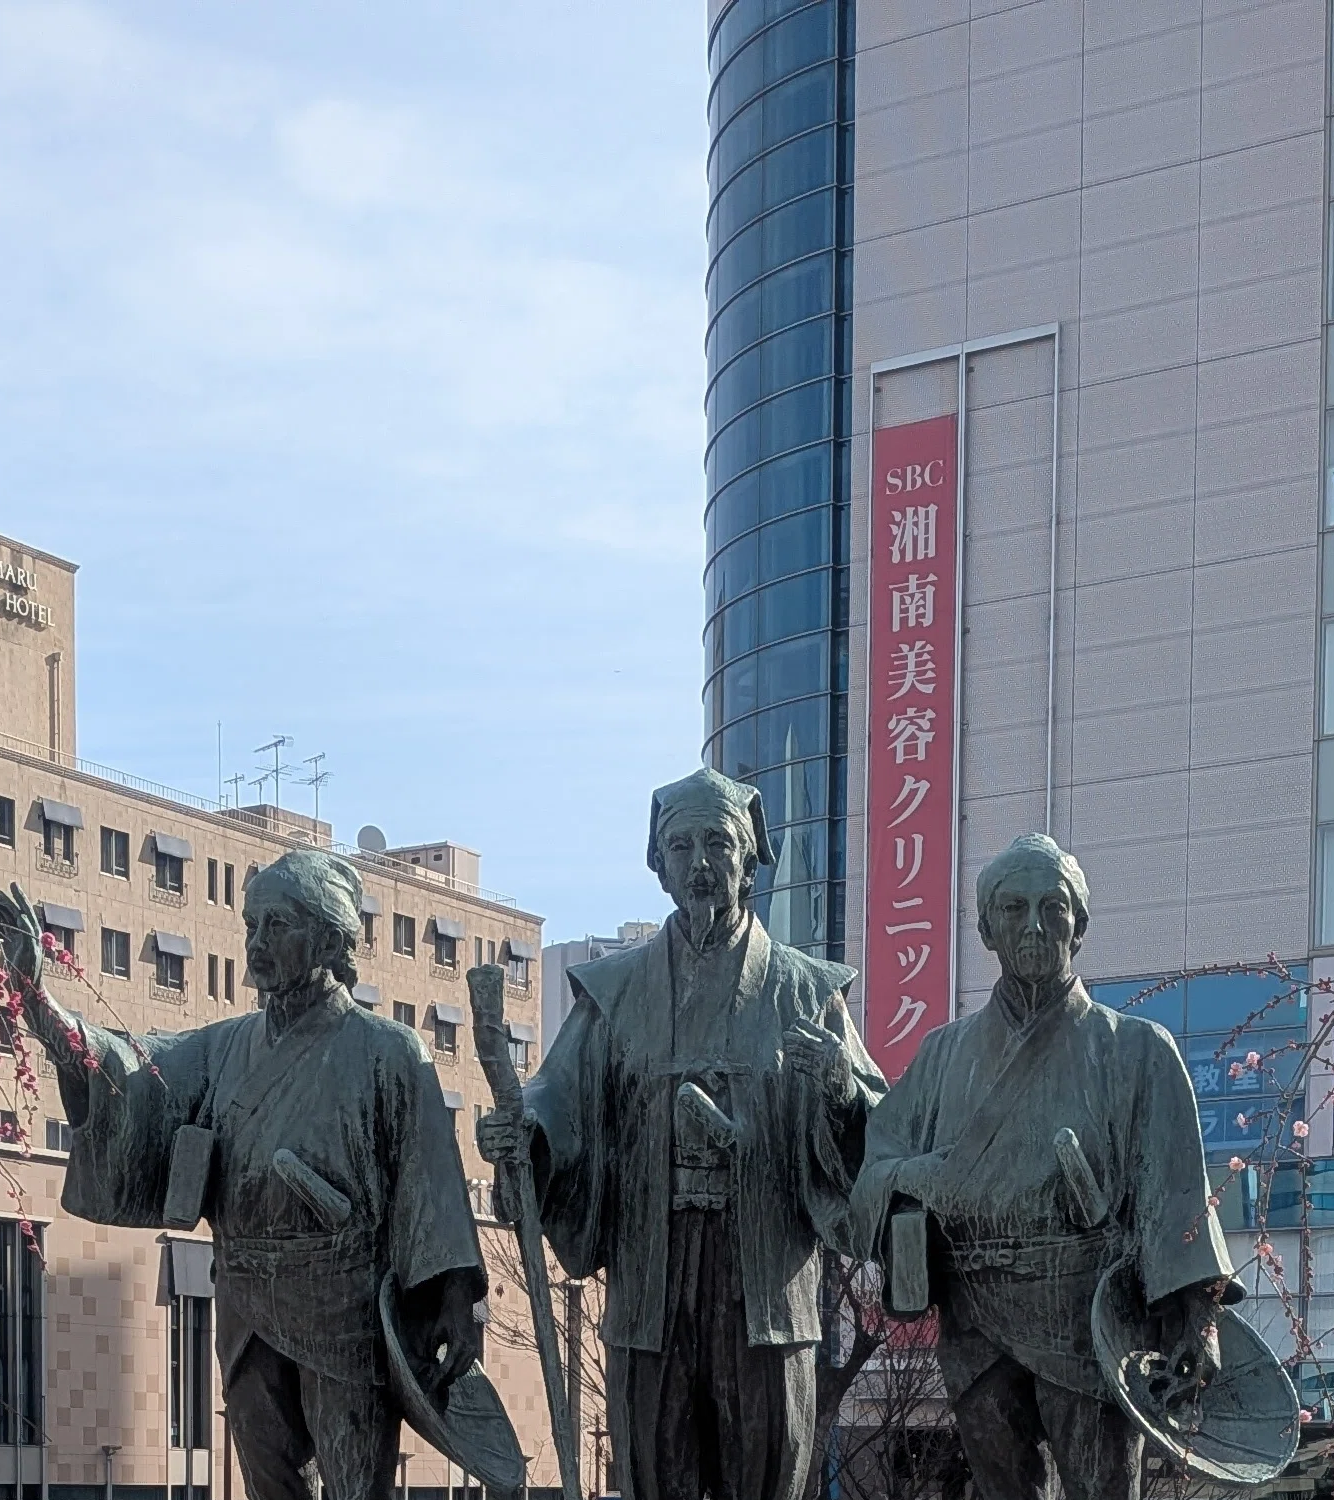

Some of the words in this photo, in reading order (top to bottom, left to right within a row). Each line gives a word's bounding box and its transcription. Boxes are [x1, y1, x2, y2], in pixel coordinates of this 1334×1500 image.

[885, 458, 945, 497] SBC
[5, 592, 56, 628] HOTEL
[883, 502, 939, 1048] 湘南美容クリニック
